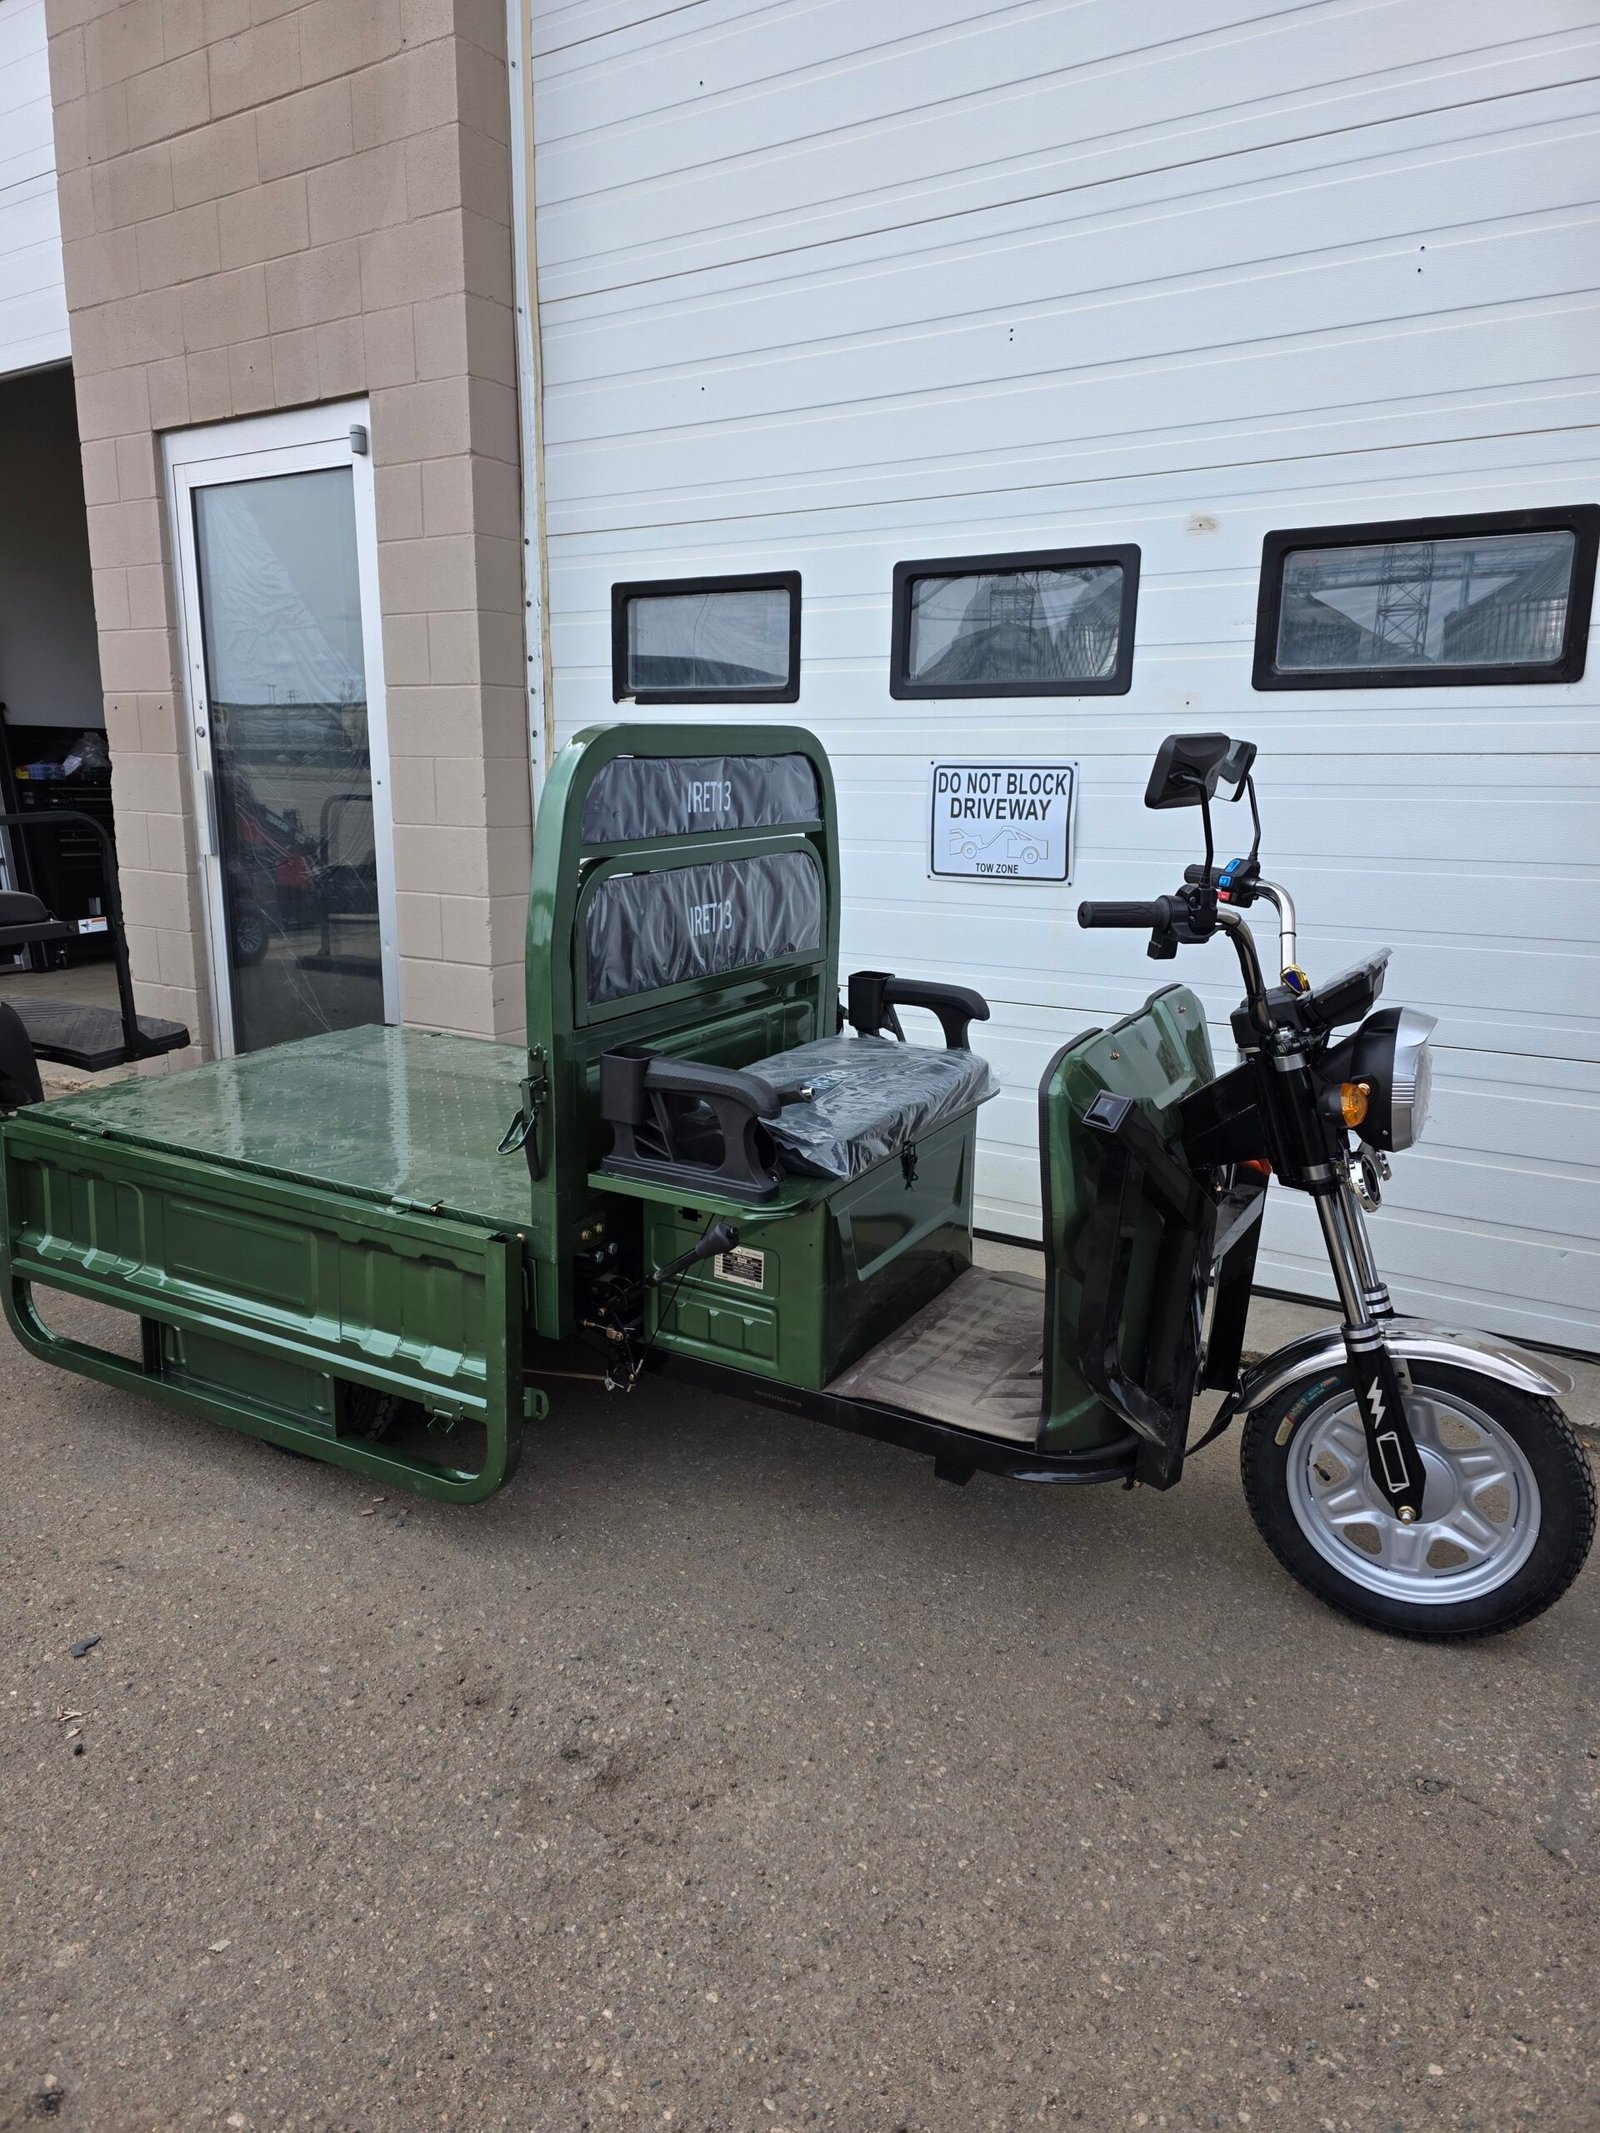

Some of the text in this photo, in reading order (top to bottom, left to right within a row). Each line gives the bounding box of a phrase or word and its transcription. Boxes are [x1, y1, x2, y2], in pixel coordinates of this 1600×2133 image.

[938, 772, 1068, 796] DO NOT BLOCK
[688, 780, 732, 813] IRET13
[950, 797, 1052, 820] DRIVEWAY
[975, 862, 1019, 874] TOW ZONE
[690, 899, 733, 937] IRET13
